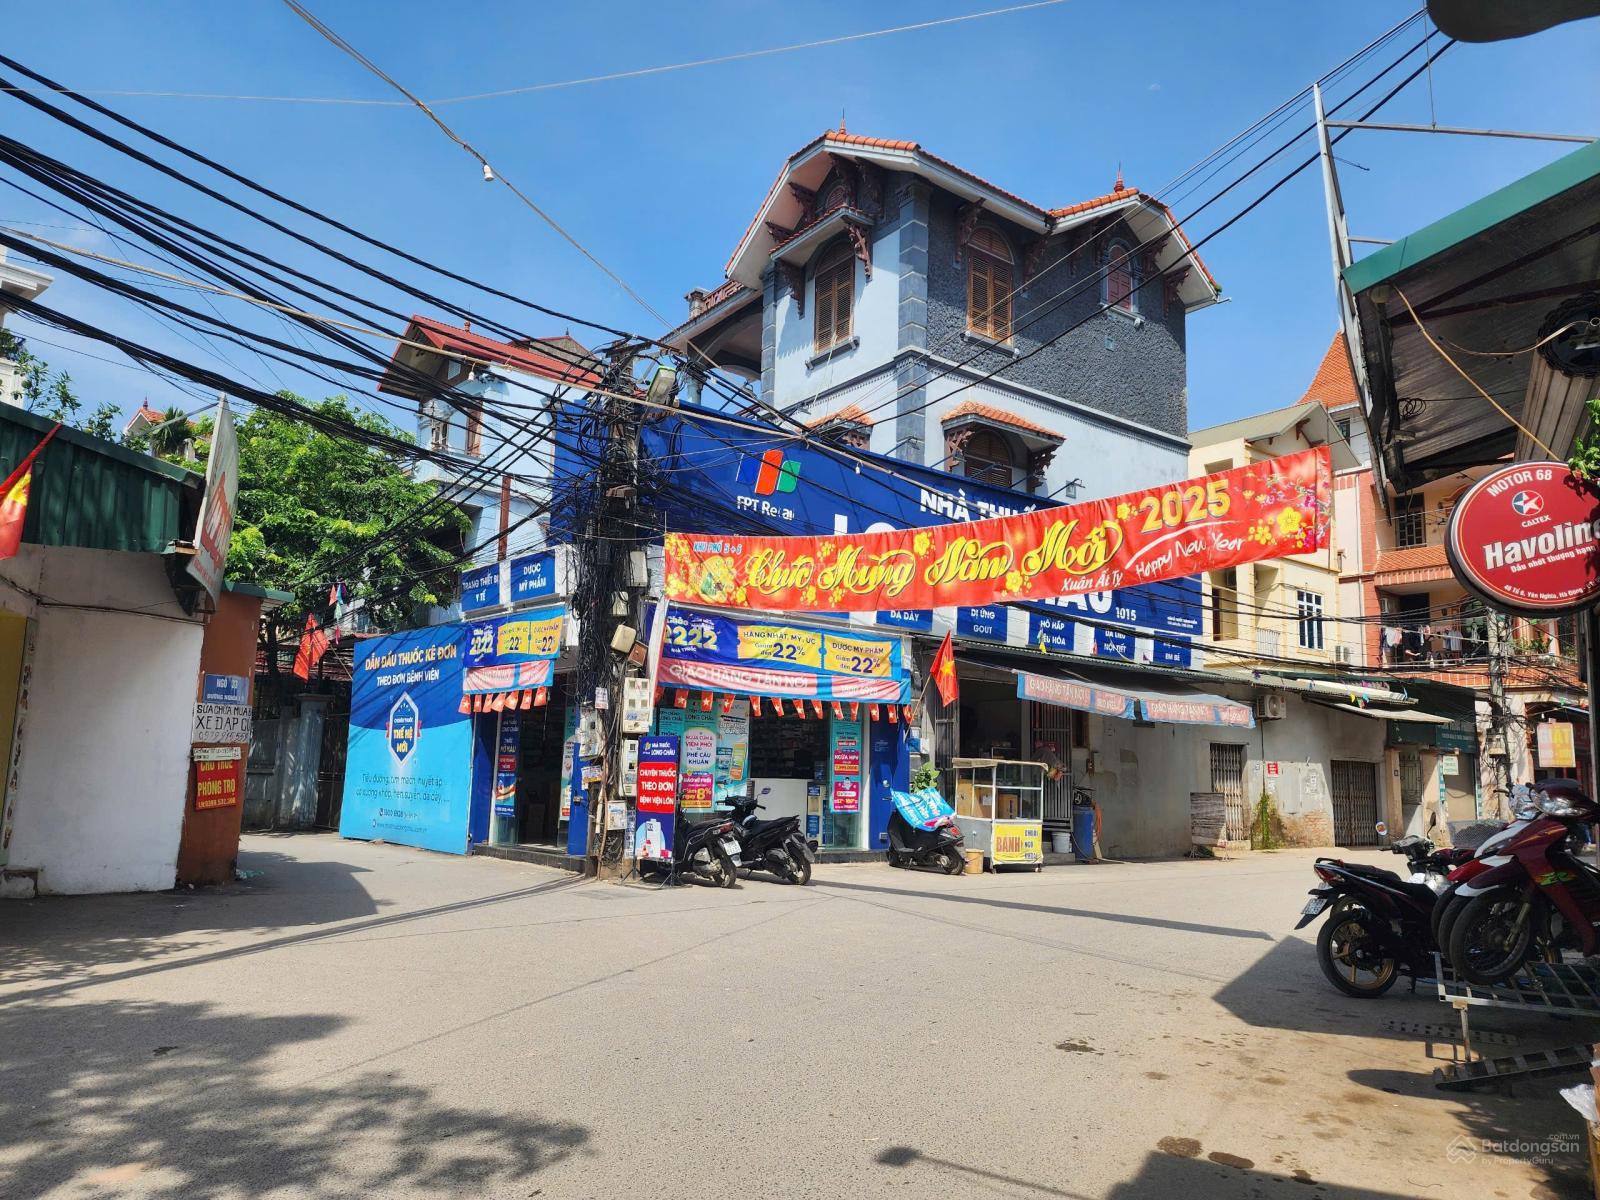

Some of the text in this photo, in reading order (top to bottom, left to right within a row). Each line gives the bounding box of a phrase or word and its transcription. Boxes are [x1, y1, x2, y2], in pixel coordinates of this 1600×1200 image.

[1487, 469, 1552, 496] MOTOR 68
[736, 495, 759, 511] FPT
[920, 488, 970, 522] NHÀ
[1138, 479, 1231, 534] 2025
[1521, 514, 1551, 528] CALTEX
[743, 548, 816, 595] Chúc
[817, 545, 916, 597] Mừng
[924, 535, 1014, 587] Năm
[1021, 518, 1124, 577] Mới
[1135, 531, 1246, 580] Happy New Year
[518, 575, 547, 592] MỸ PHẨM
[1061, 576, 1093, 592] Xuân
[970, 607, 996, 619] DỊ ỨNG
[1115, 607, 1136, 621] 1015
[973, 624, 992, 635] GOUT
[1052, 620, 1065, 630] HẤP
[1052, 635, 1066, 646] HÓA
[398, 645, 424, 666] THUỐC
[437, 642, 457, 660] ĐƠN
[377, 675, 392, 687] THEO
[392, 672, 406, 684] ĐƠN
[424, 667, 440, 682] VIỆN
[195, 715, 213, 730] XE
[214, 716, 239, 732] ĐẠP
[641, 781, 673, 791] THEO ĐƠN
